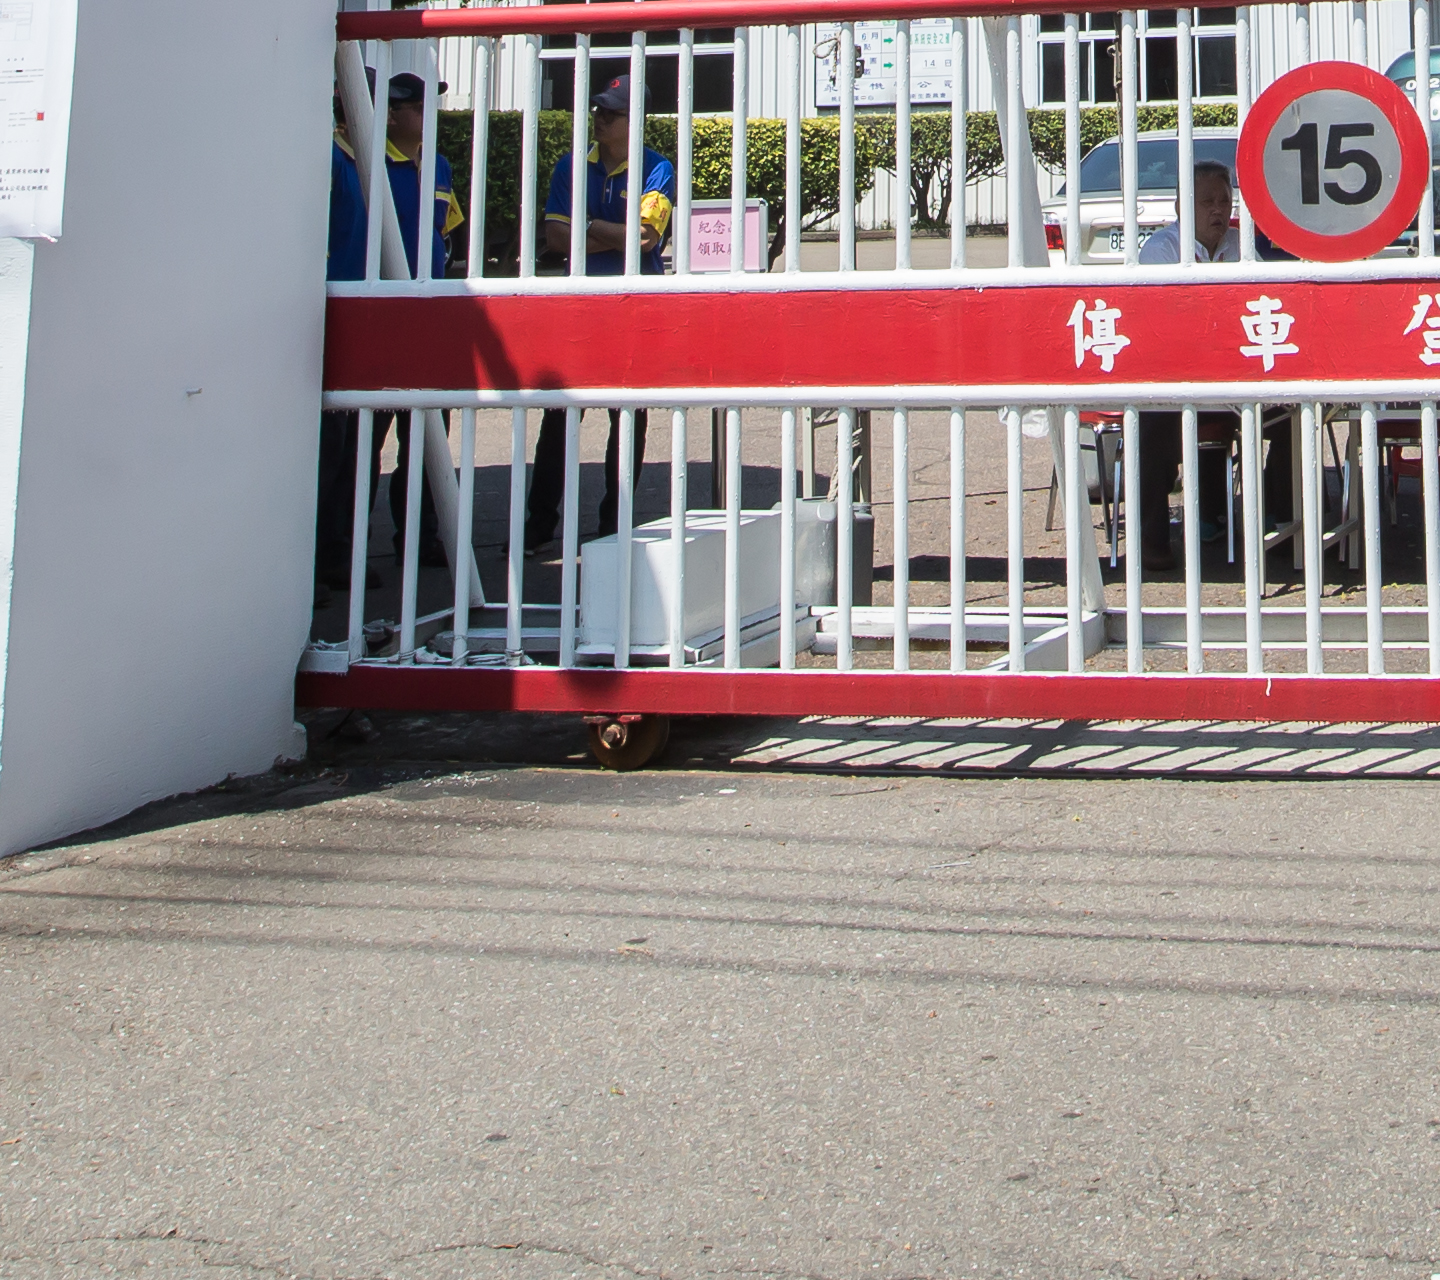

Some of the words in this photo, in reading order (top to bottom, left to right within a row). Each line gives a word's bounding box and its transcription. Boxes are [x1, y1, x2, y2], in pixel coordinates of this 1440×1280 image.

[1280, 121, 1383, 206] 15
[698, 219, 731, 235] 紀念
[697, 242, 731, 256] 領取
